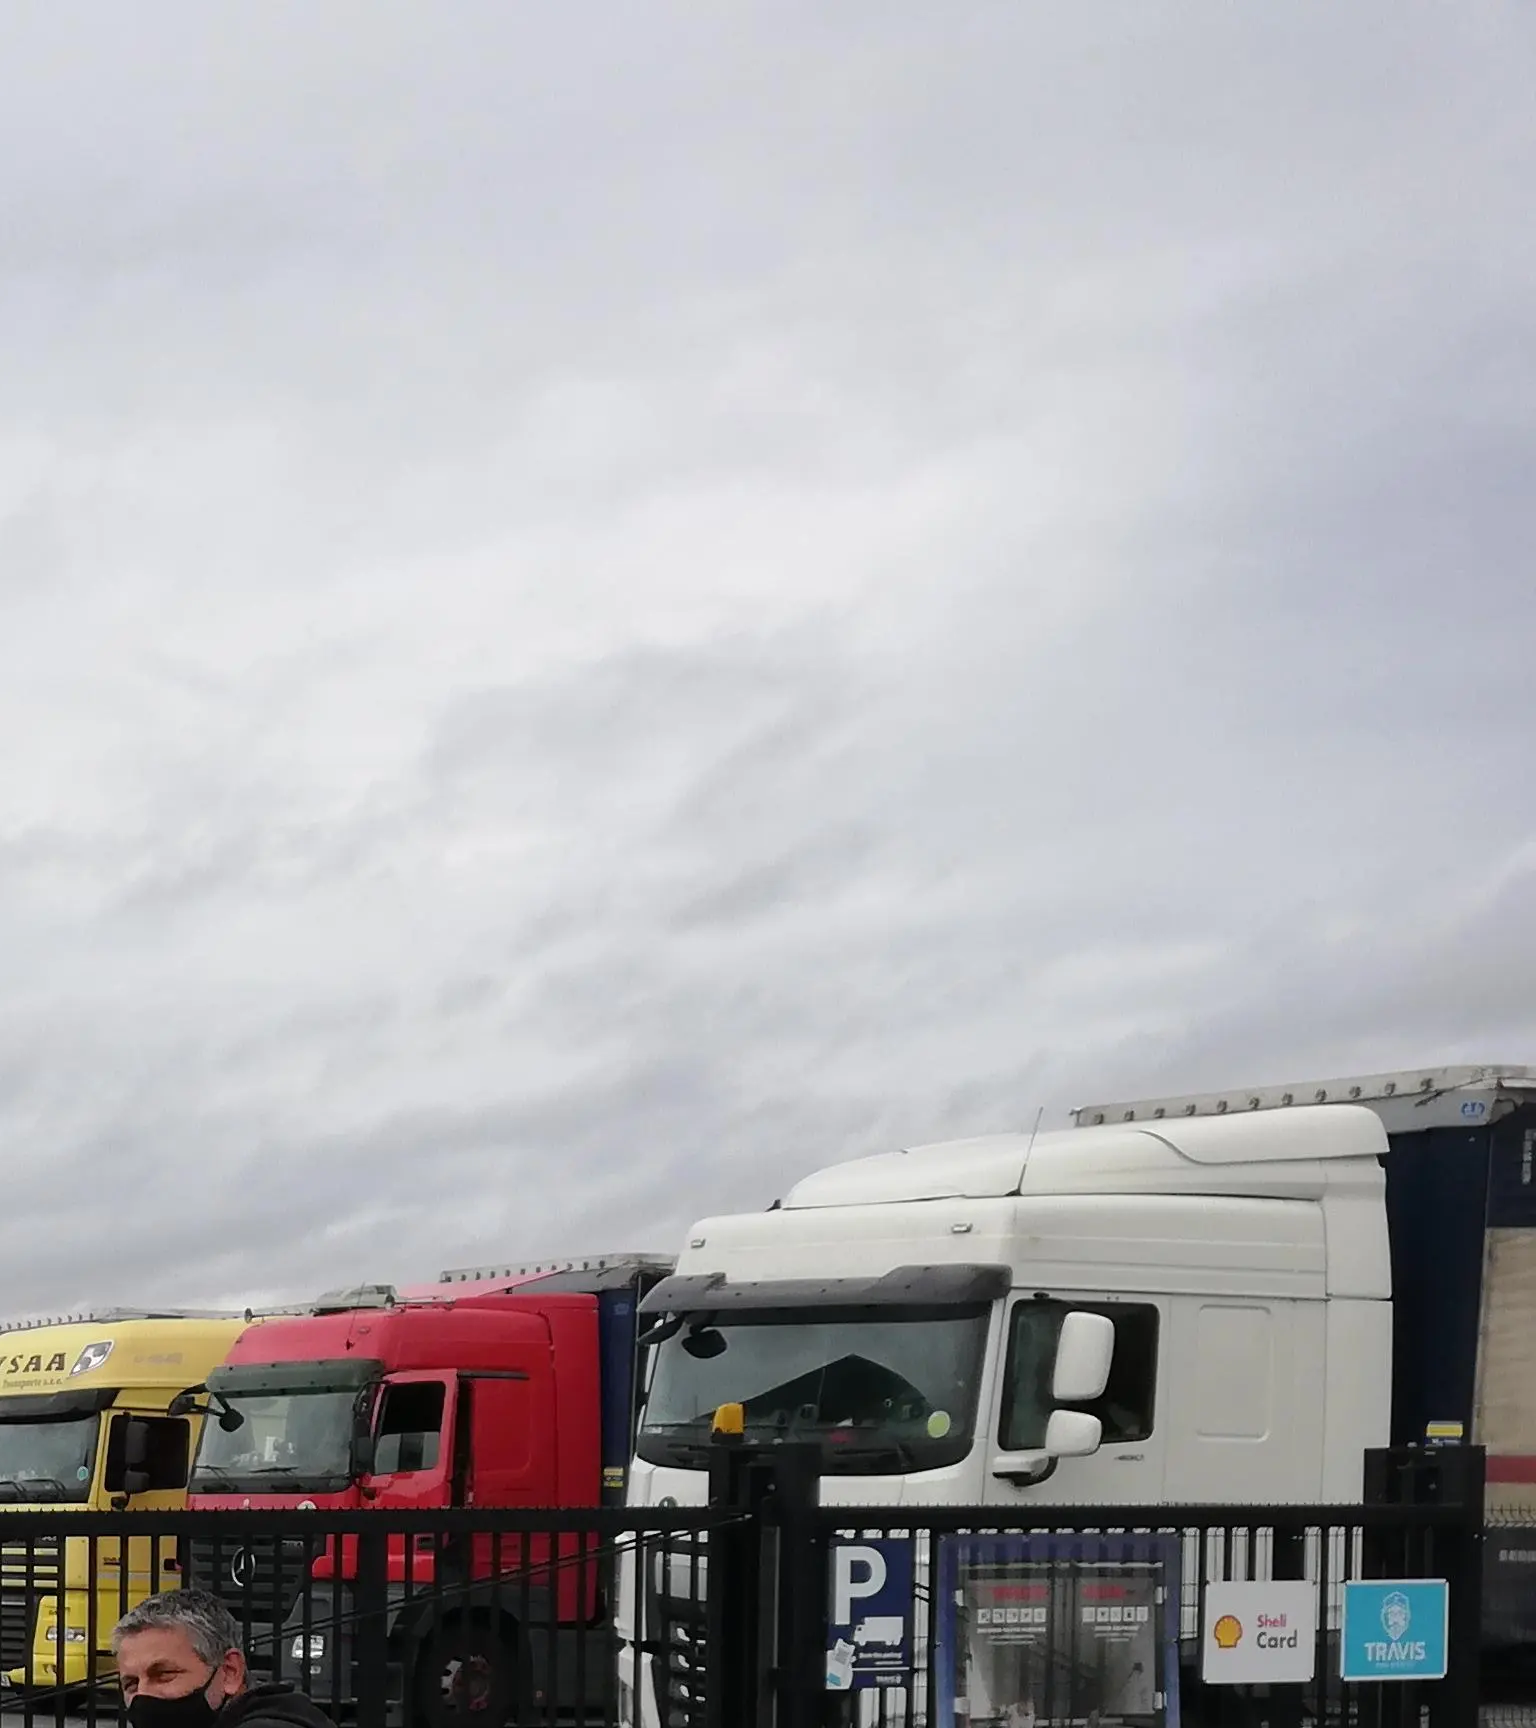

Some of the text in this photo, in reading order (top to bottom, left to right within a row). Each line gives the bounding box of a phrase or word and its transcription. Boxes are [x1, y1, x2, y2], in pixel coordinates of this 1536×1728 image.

[7, 1352, 66, 1374] SAA
[835, 1546, 887, 1625] P
[1257, 1614, 1286, 1628] Shell
[1257, 1631, 1297, 1649] Card
[1365, 1642, 1425, 1661] TRAVIS
